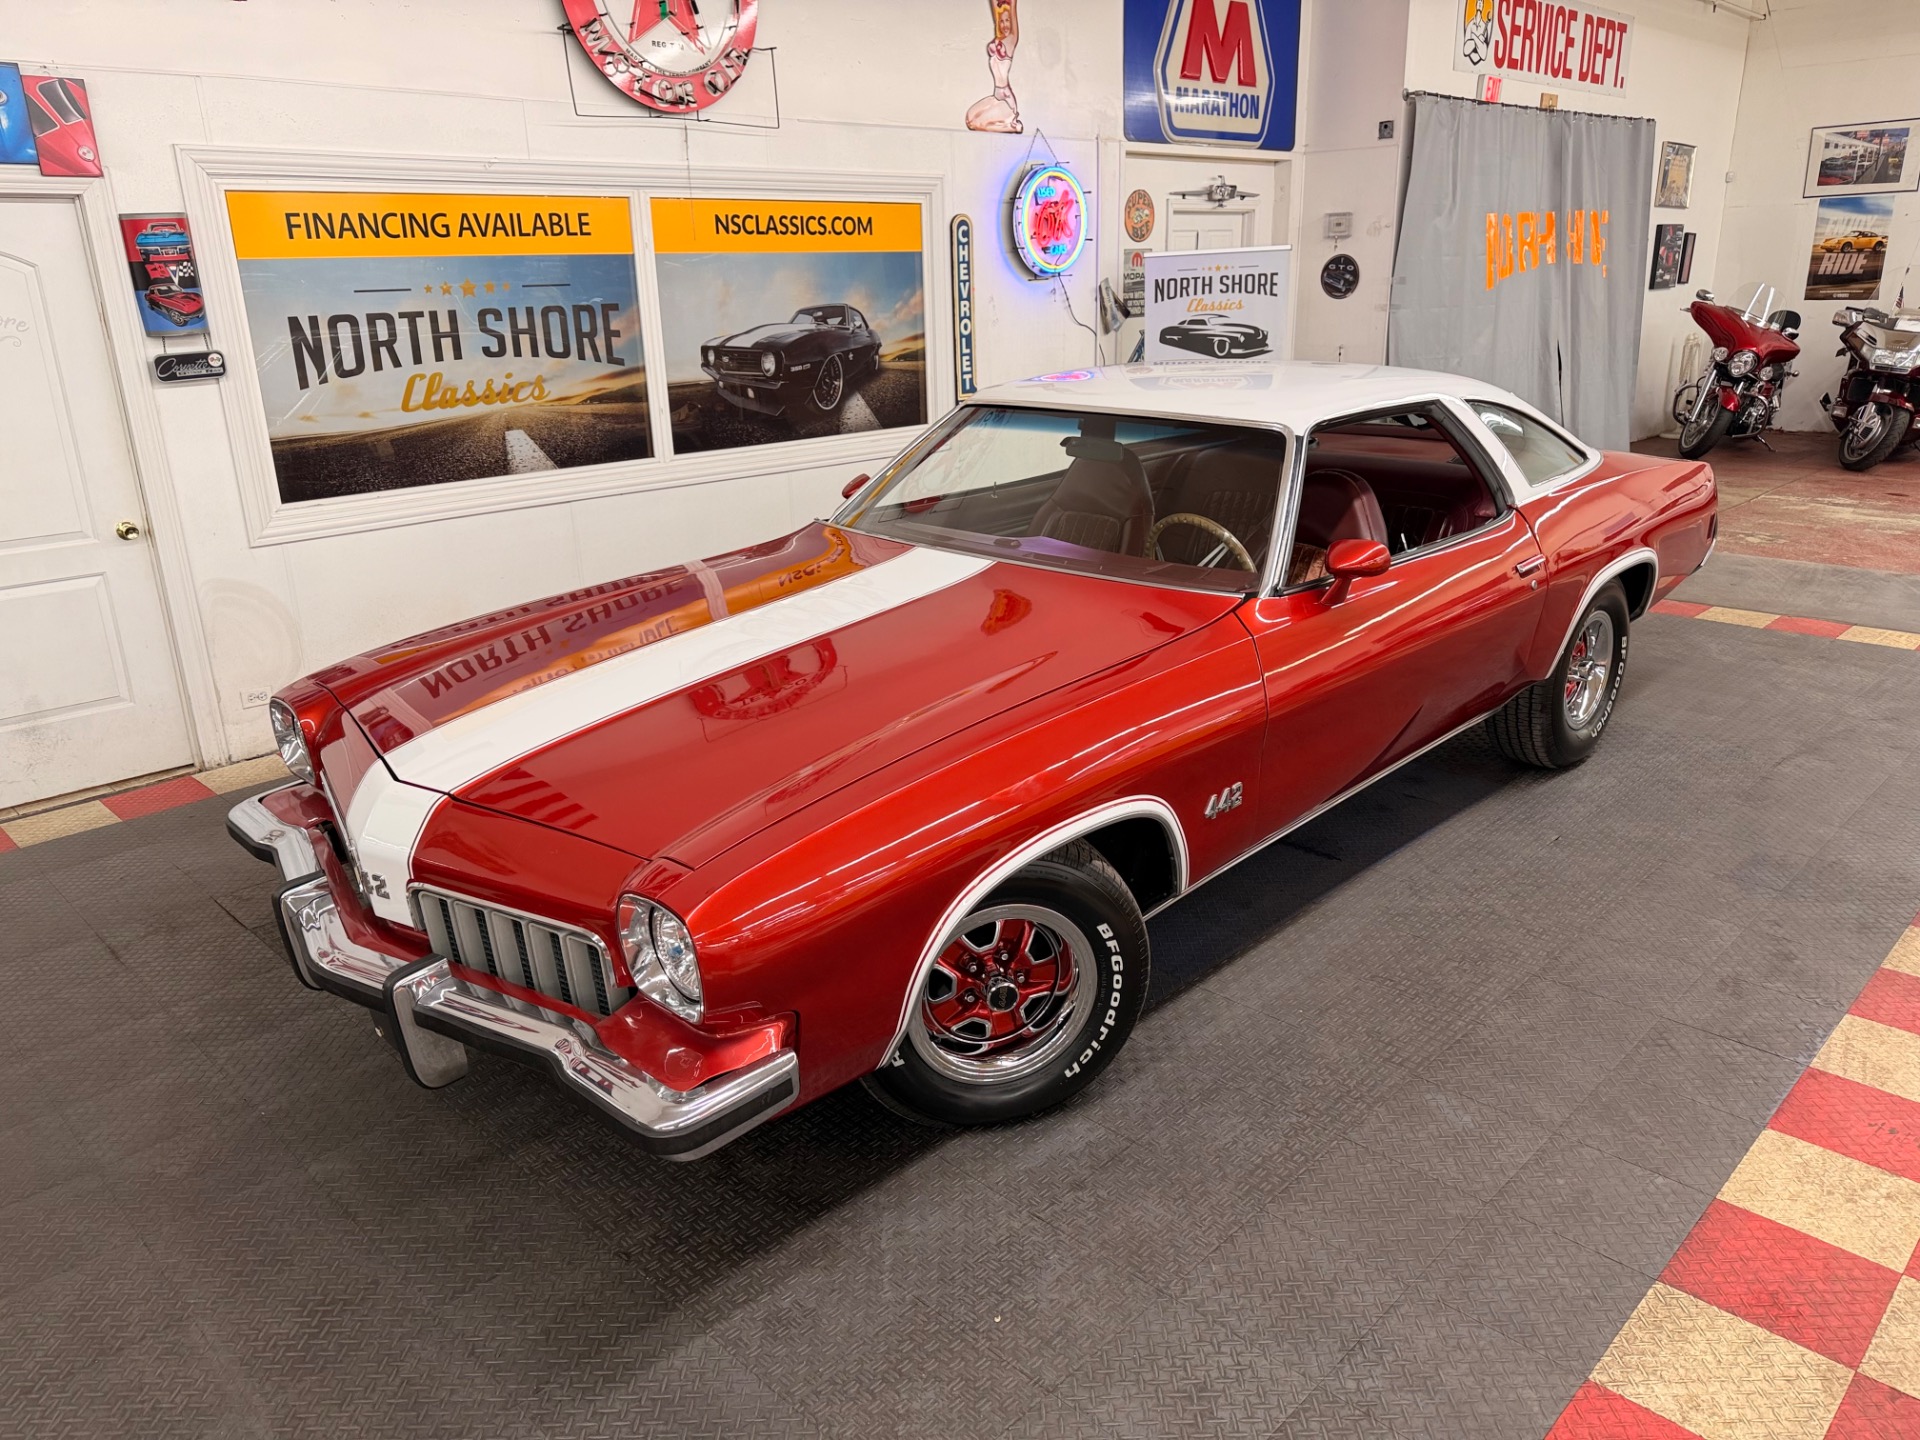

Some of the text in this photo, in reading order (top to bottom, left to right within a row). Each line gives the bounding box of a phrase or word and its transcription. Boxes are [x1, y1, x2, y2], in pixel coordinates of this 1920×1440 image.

[1493, 0, 1628, 89] SERVICE DEPT.
[1174, 86, 1260, 120] MARATHON
[286, 211, 591, 241] FINANCING AVAILABLE
[714, 212, 874, 237] NSCLASSICS.COM
[1131, 220, 1151, 240] BEE
[1122, 272, 1146, 281] MOPA
[1817, 252, 1869, 275] RIDE
[1154, 271, 1279, 304] NORTH SHORE
[957, 224, 973, 391] CHEVROLET
[1185, 298, 1245, 313] Classics
[287, 302, 626, 390] NORTH SHORE
[400, 372, 551, 414] Classics
[1204, 781, 1243, 819] 442
[1064, 922, 1124, 1078] BFGoodrich
